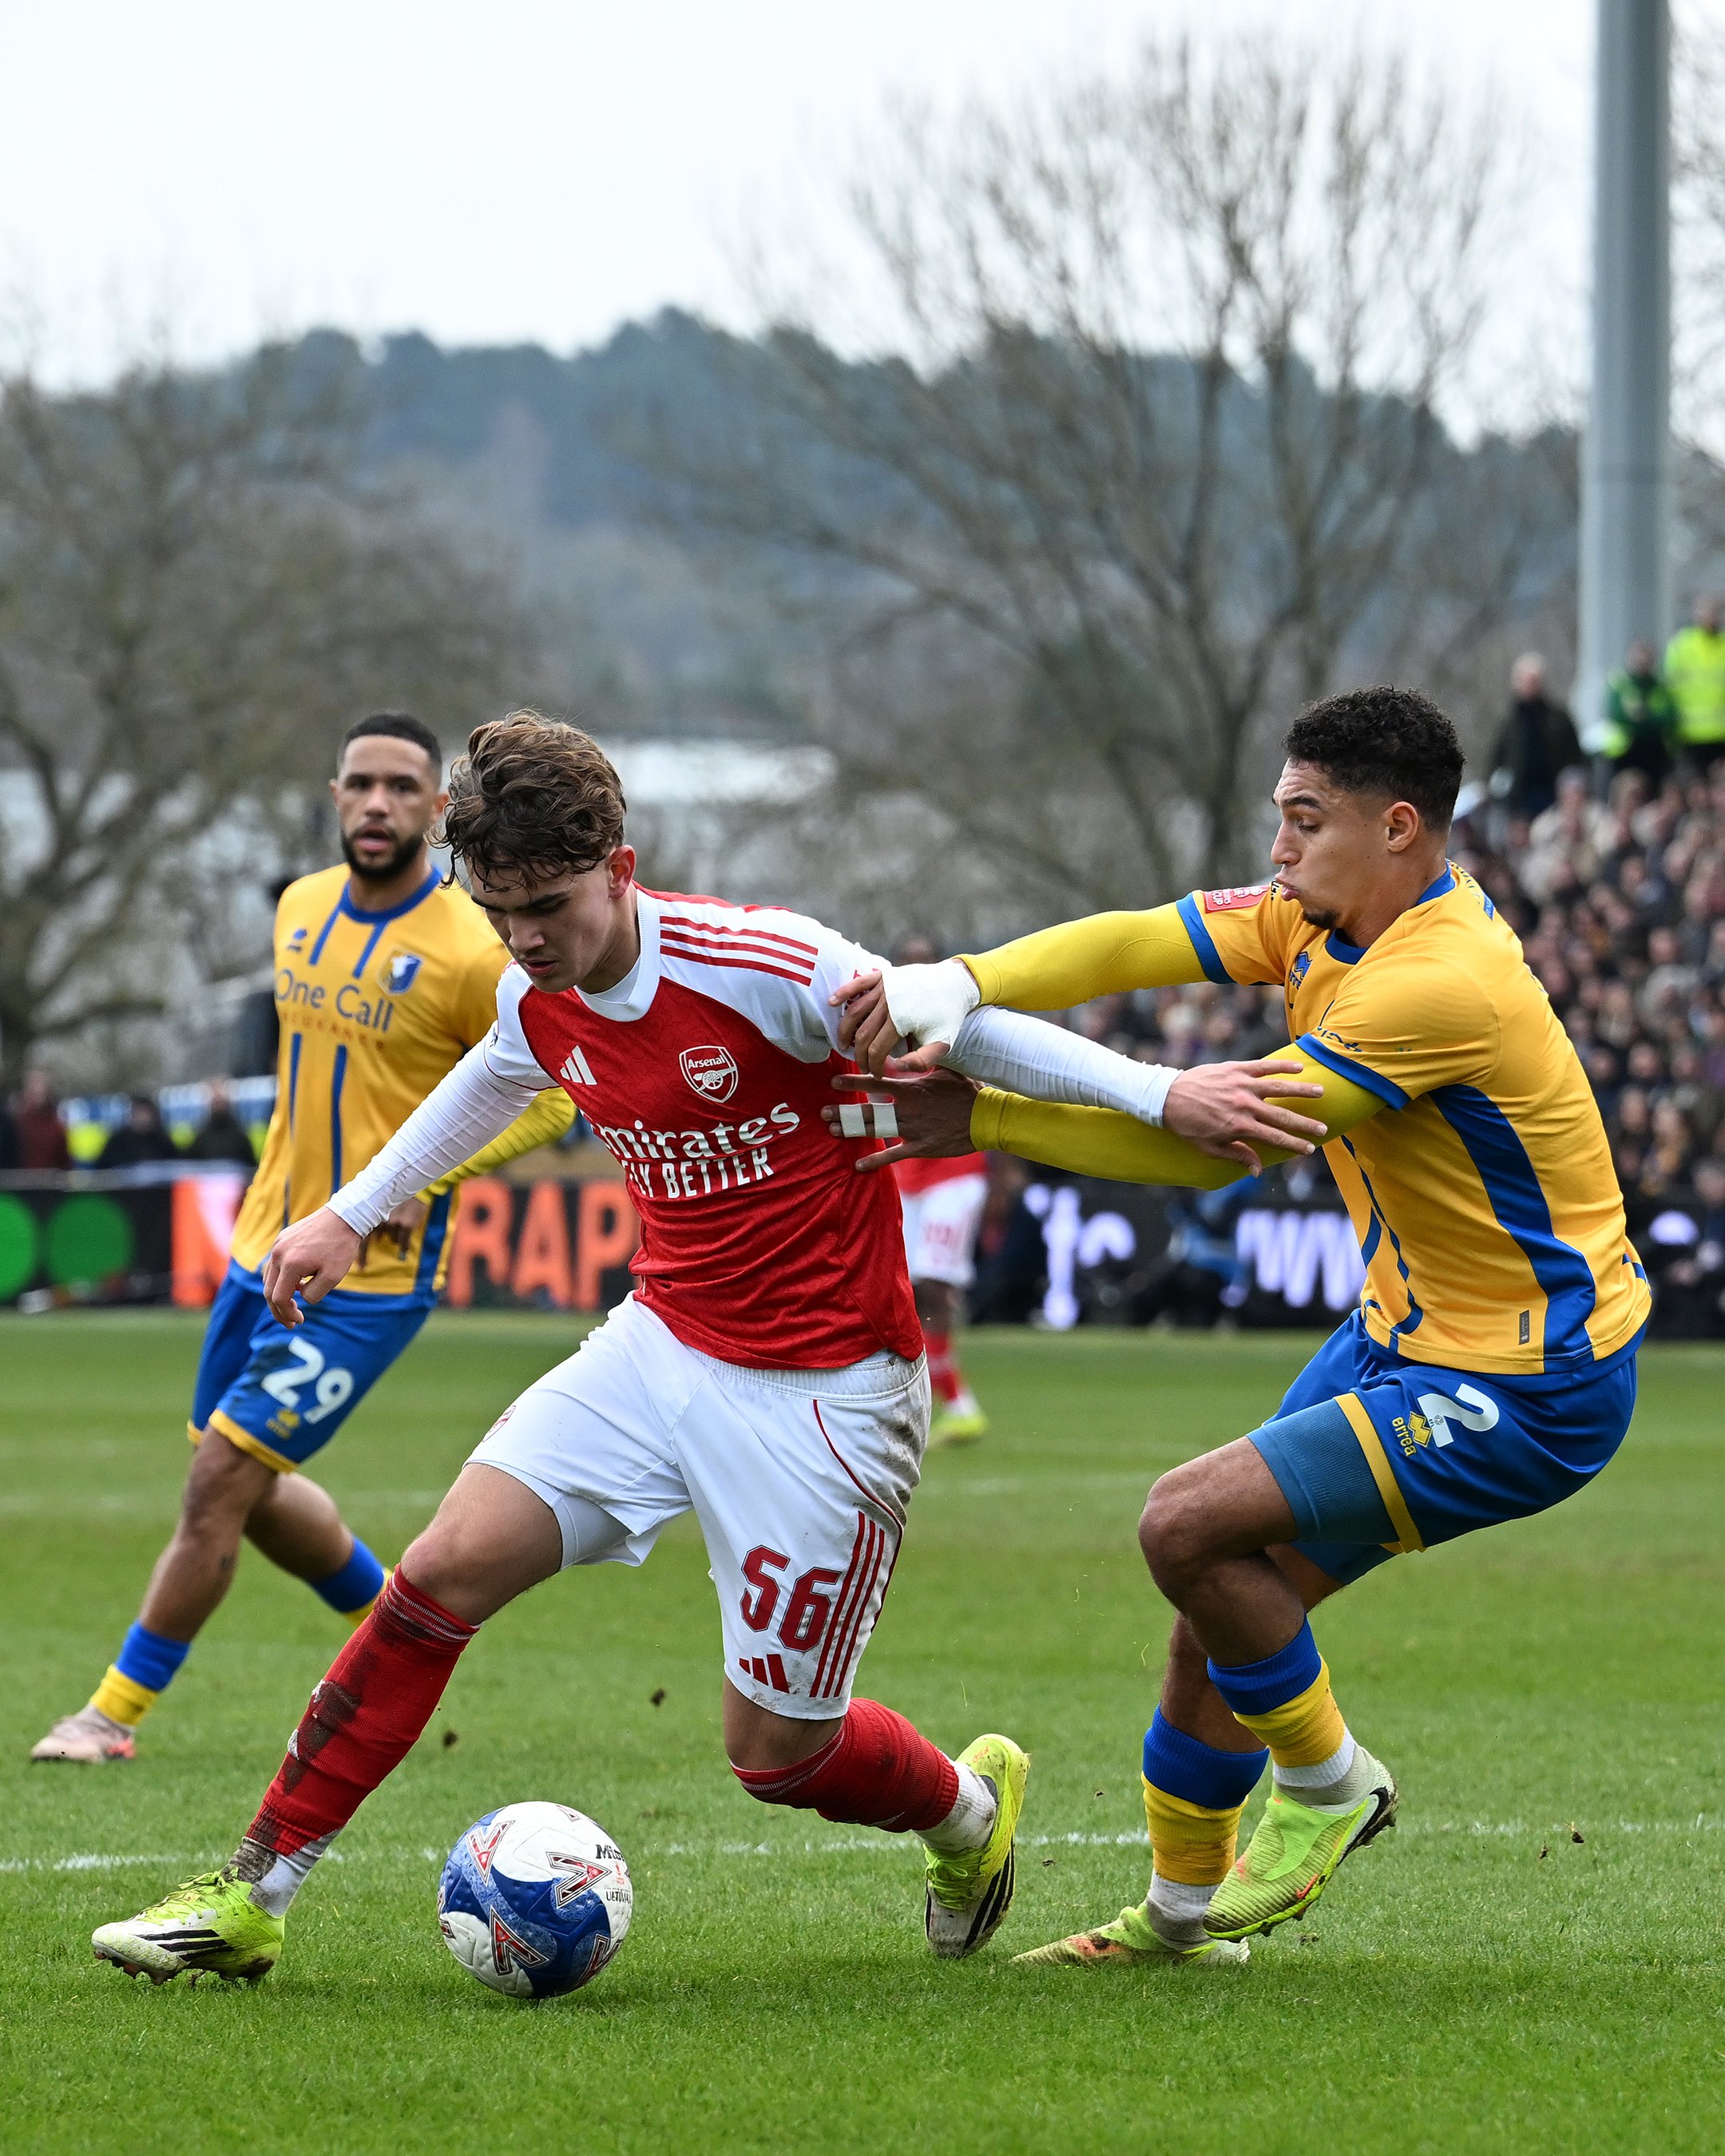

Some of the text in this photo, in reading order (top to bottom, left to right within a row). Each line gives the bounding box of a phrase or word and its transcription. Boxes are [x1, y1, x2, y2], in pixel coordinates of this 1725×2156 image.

[275, 969, 326, 1009] One
[335, 984, 395, 1032] Call
[688, 1054, 726, 1069] Arsenal
[580, 1103, 800, 1159] mirates
[661, 1147, 774, 1199] BETTER
[260, 1336, 355, 1425] 29
[1417, 1382, 1500, 1448] 2
[740, 1544, 843, 1653] 56
